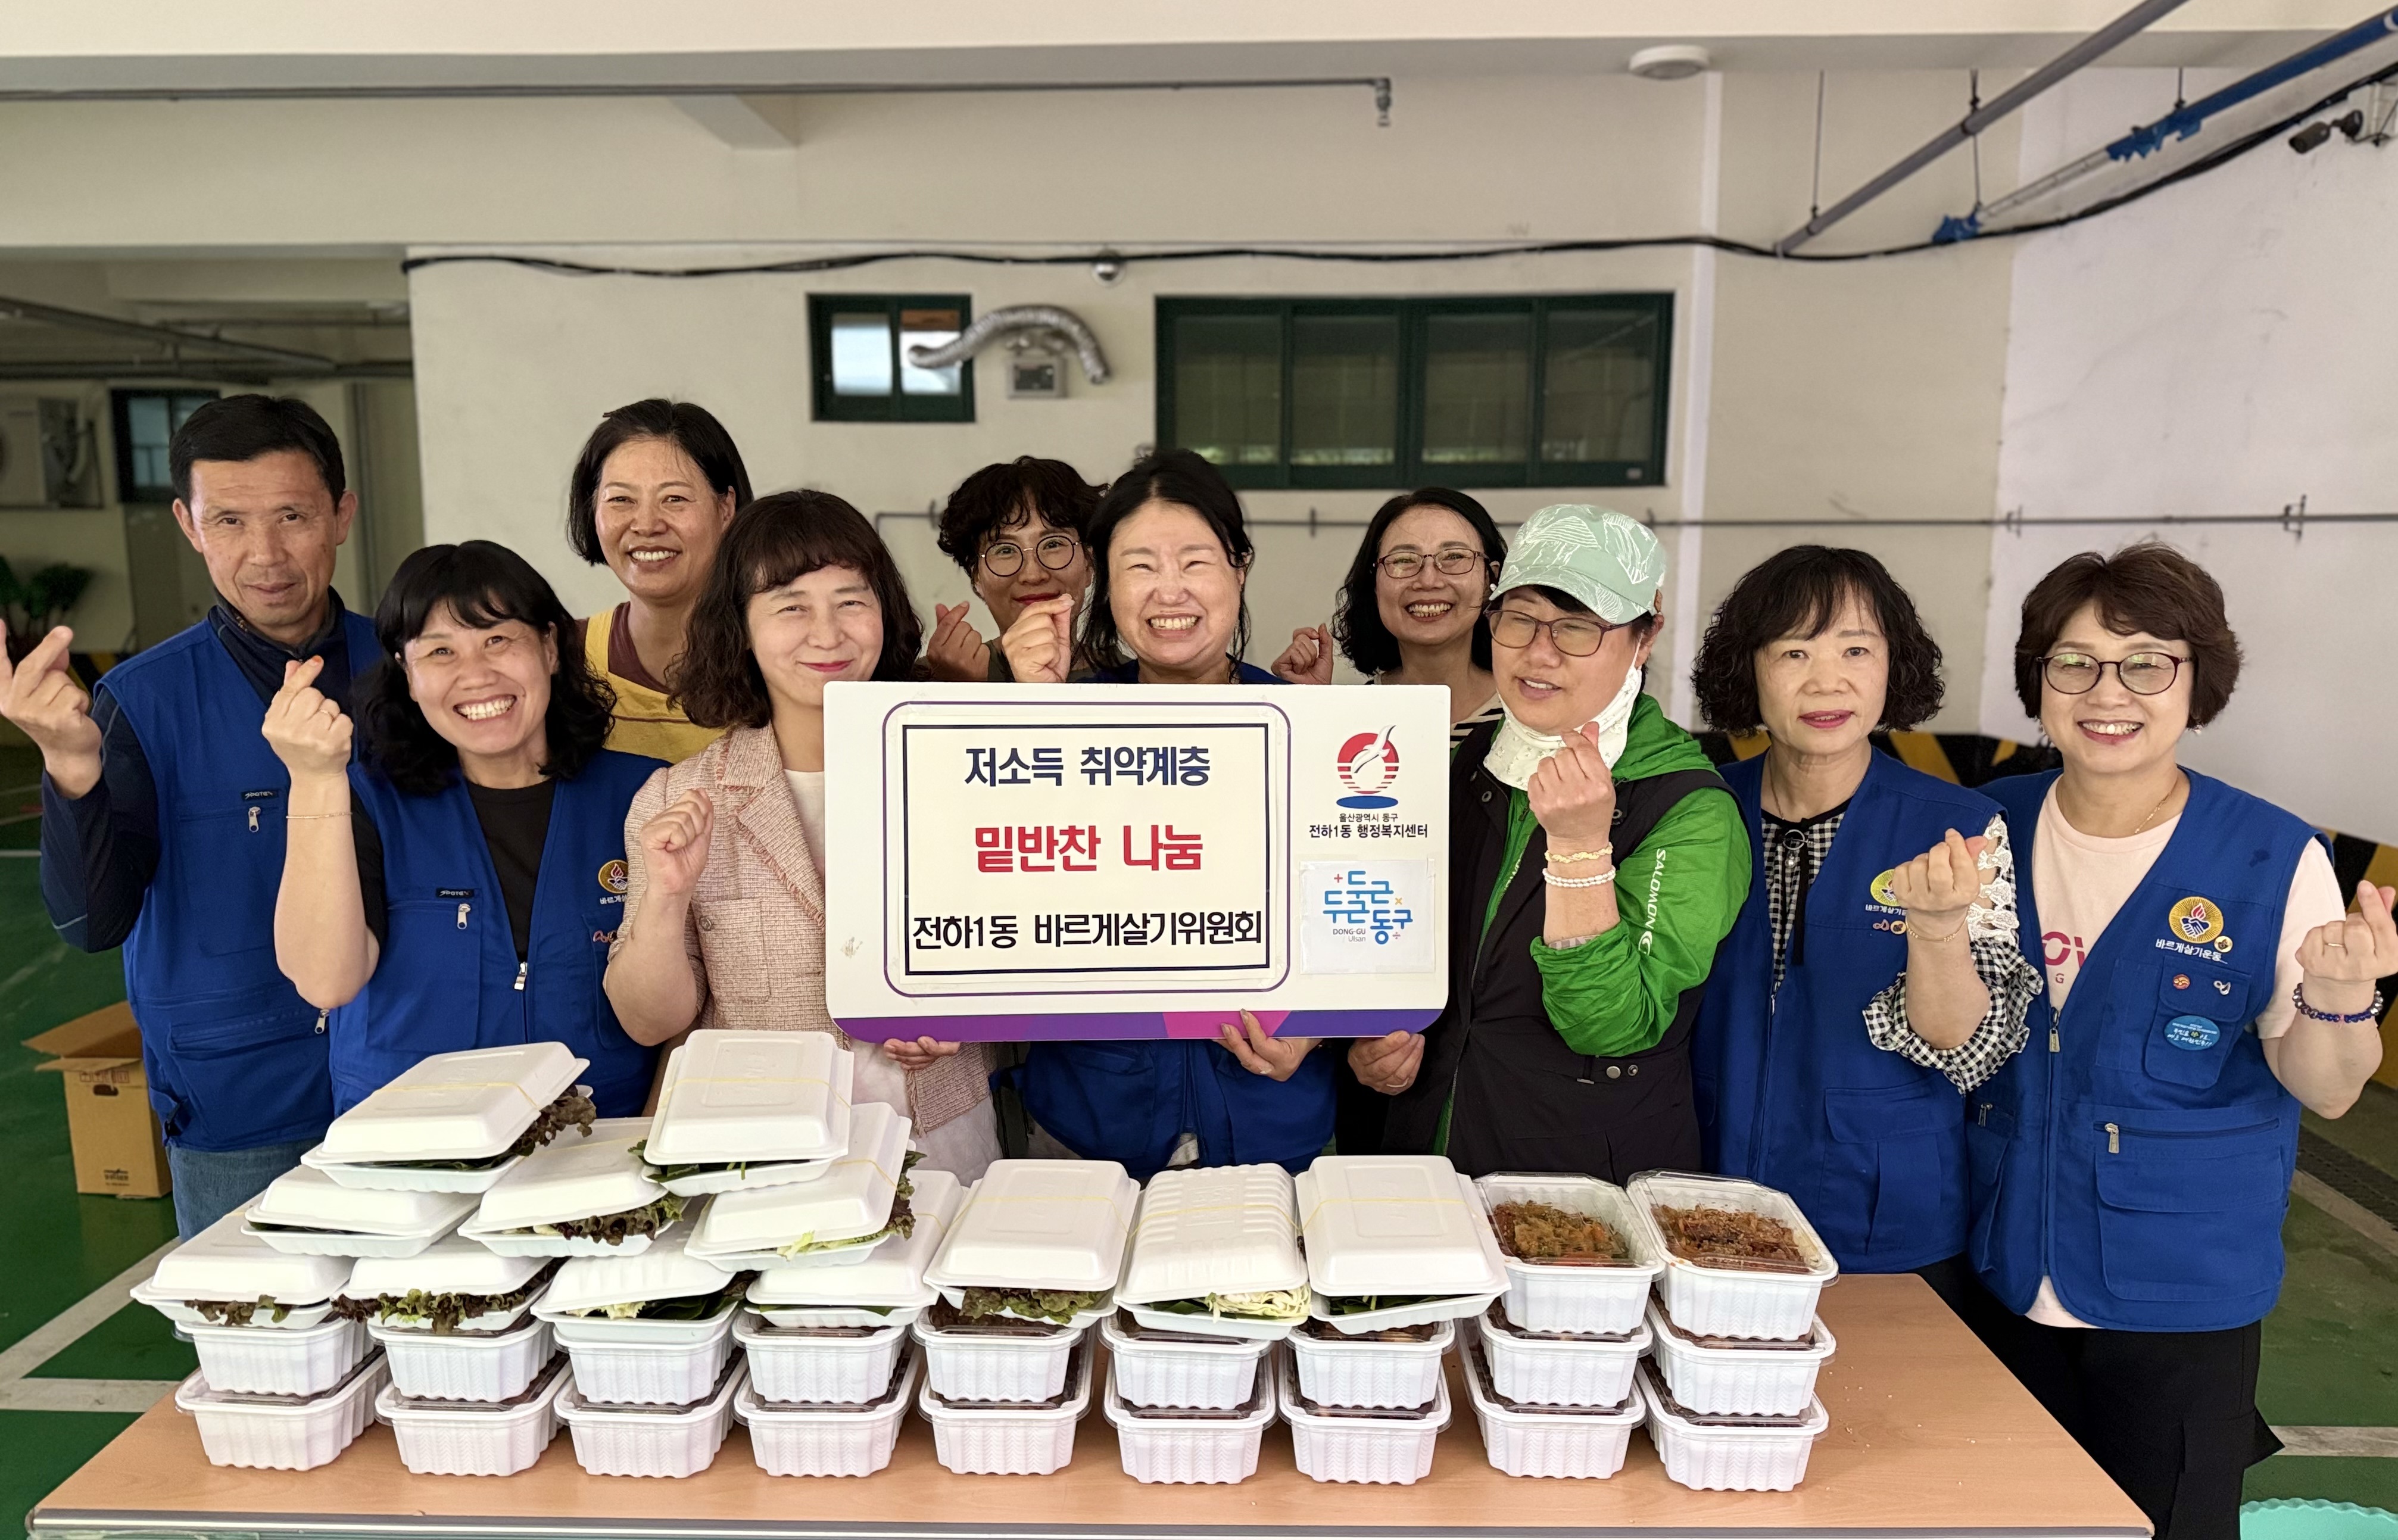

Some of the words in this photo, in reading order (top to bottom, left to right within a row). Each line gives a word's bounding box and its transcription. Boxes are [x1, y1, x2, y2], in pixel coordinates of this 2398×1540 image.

[965, 747, 1064, 787] 저소득
[1080, 746, 1211, 786] 취약계층
[1309, 824, 1352, 838] 전하1동
[1357, 824, 1428, 838] 행정복지센터
[1339, 813, 1379, 822] 울산광역시
[1382, 813, 1398, 822] 동구
[975, 825, 1102, 872] 밑반찬
[1123, 824, 1203, 871] 나눔
[1645, 848, 1666, 930] SALOMON
[912, 915, 1018, 949] 전하1동
[1034, 911, 1262, 947] 바르게살기위원회
[1370, 909, 1413, 944] 동구
[2155, 939, 2222, 962] 바르게살기운동
